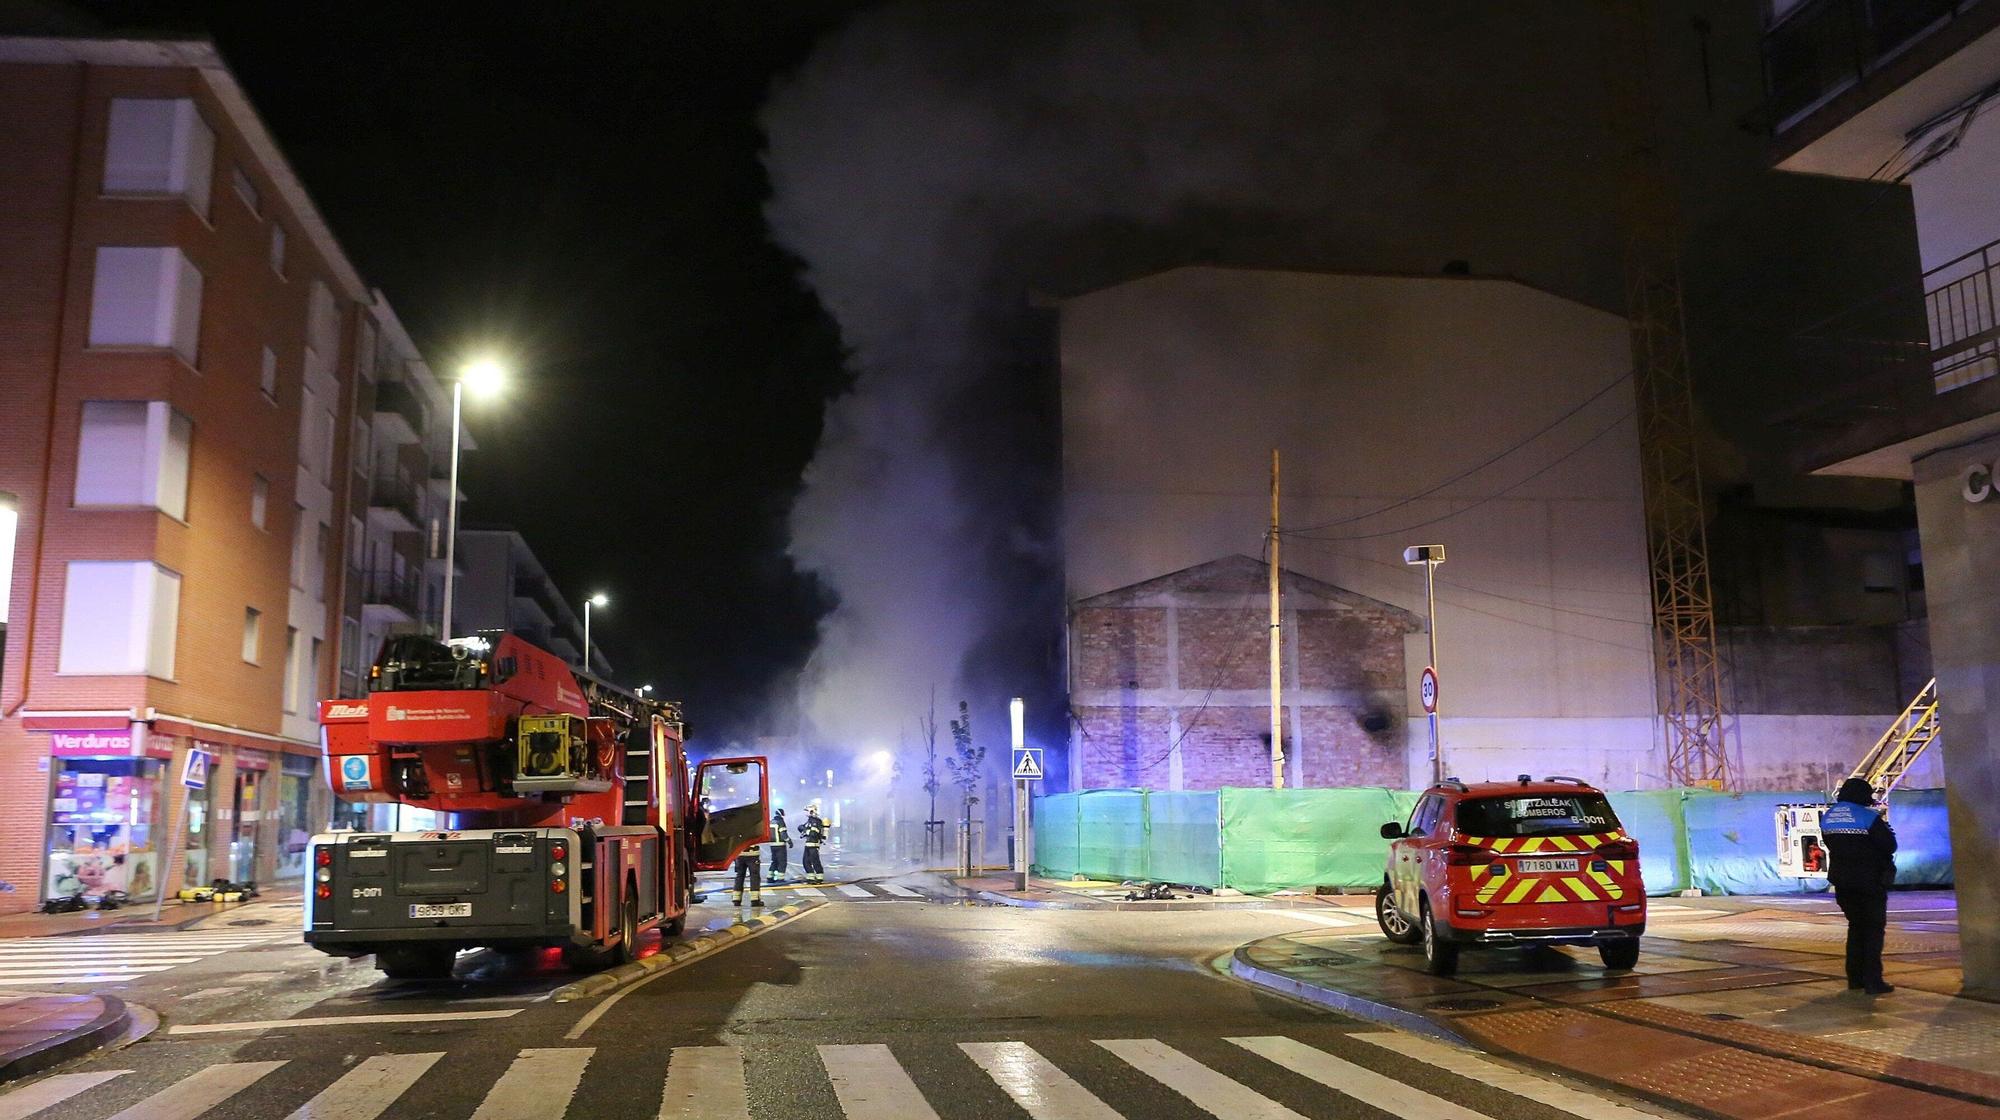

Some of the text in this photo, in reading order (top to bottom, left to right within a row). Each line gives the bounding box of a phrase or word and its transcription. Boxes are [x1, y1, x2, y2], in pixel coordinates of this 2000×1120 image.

[1424, 682, 1433, 697] 30
[54, 733, 131, 749] Verduras
[1571, 816, 1605, 825] B-0011
[1525, 861, 1552, 870] 7180
[353, 888, 382, 898] B-0171
